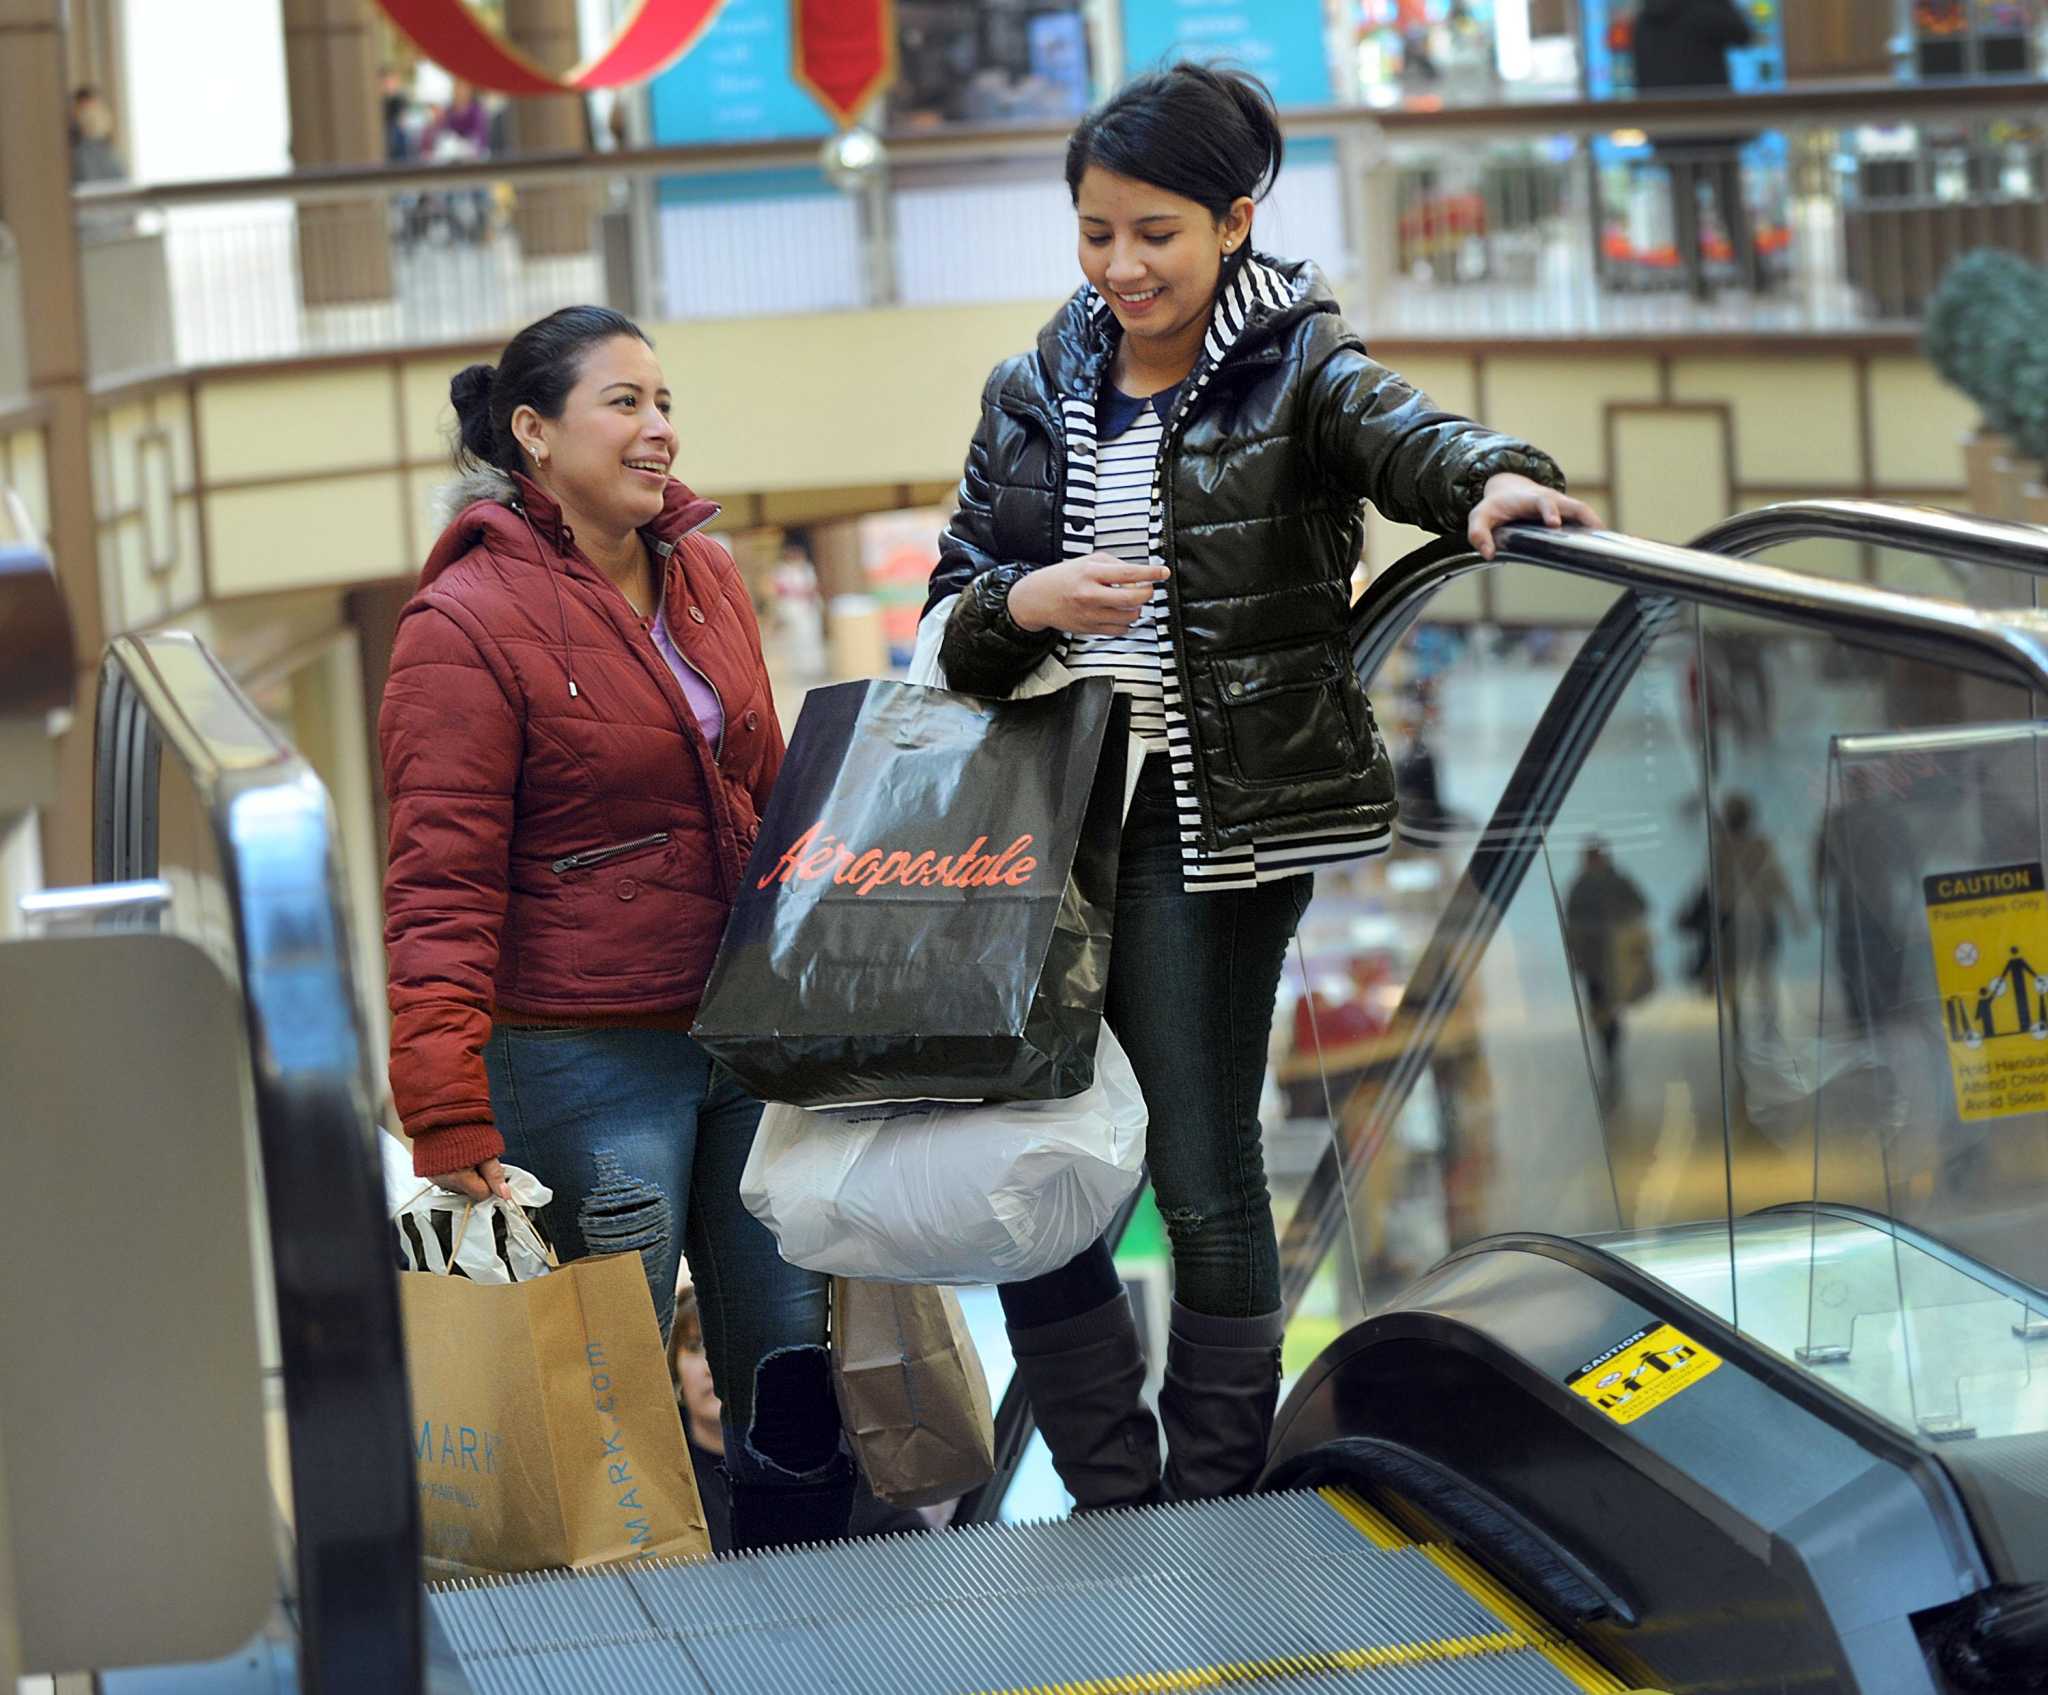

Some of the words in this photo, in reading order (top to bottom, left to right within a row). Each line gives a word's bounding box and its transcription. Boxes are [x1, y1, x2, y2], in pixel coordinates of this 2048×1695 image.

[757, 821, 1037, 896] Aéropostale
[1937, 870, 2031, 898] CAUTION
[1581, 1330, 1646, 1373] CAUTION
